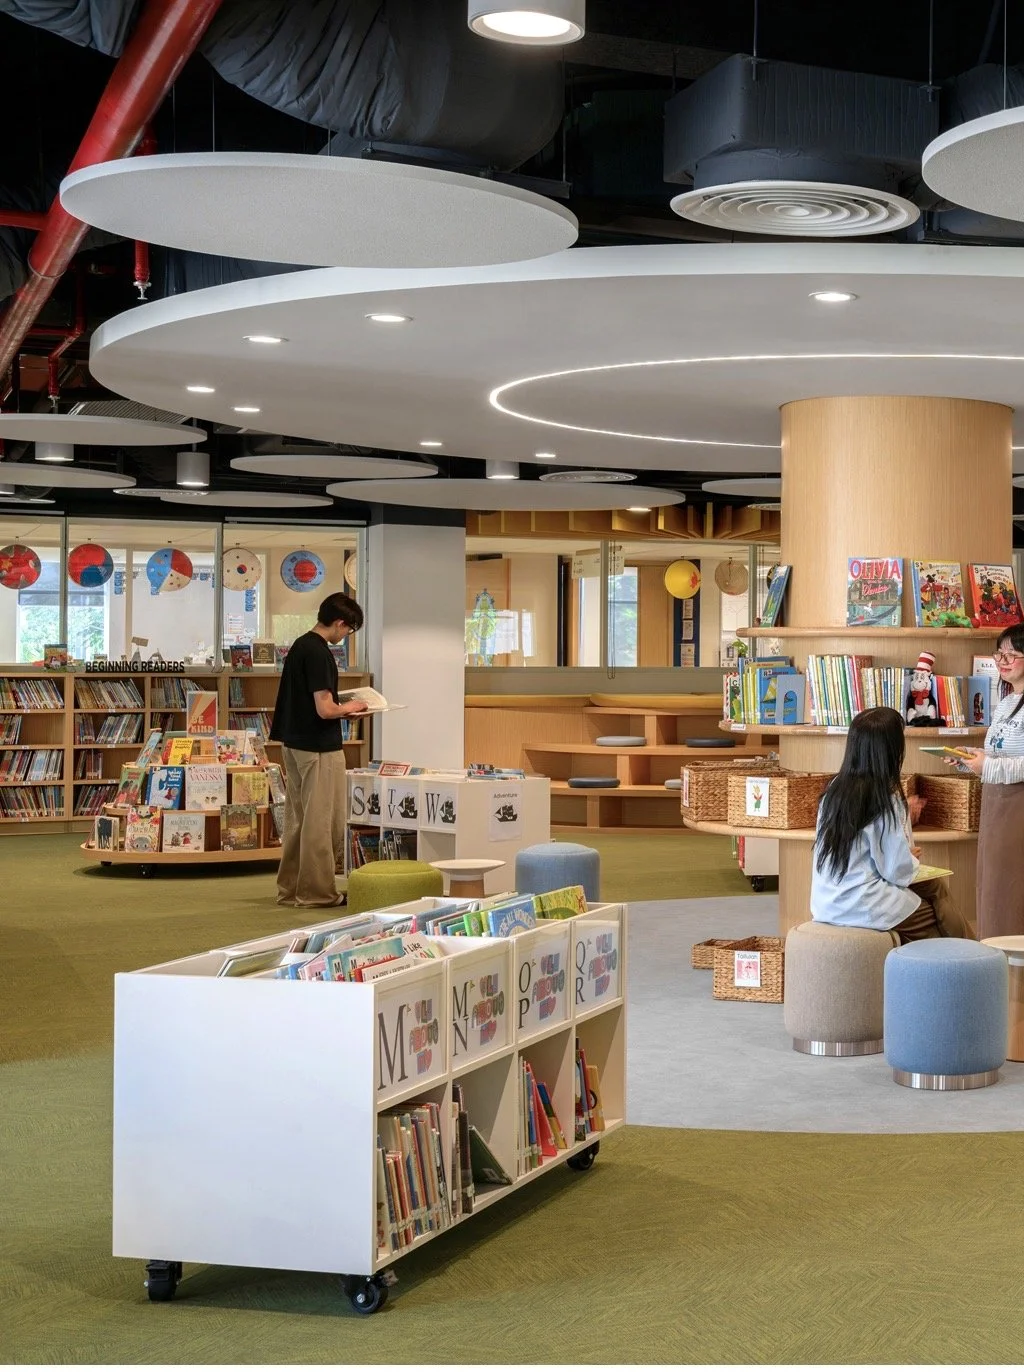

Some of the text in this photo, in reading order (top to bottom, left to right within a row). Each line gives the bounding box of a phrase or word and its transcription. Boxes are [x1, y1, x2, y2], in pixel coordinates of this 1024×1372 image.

[850, 559, 901, 580] OLIVIA
[86, 661, 184, 672] BEGINNING READERS
[191, 716, 204, 724] BE
[191, 725, 214, 734] KIND
[352, 786, 366, 816] S
[388, 789, 396, 804] T
[426, 793, 440, 824] W
[388, 804, 396, 819] V
[408, 942, 422, 954] Like
[576, 940, 586, 975] Q
[334, 961, 341, 974] M
[351, 960, 358, 970] M
[518, 961, 531, 993] O
[452, 981, 469, 1021] M
[576, 976, 585, 1004] R
[518, 998, 530, 1030] P
[378, 1004, 408, 1090] M
[452, 1018, 468, 1056] N
